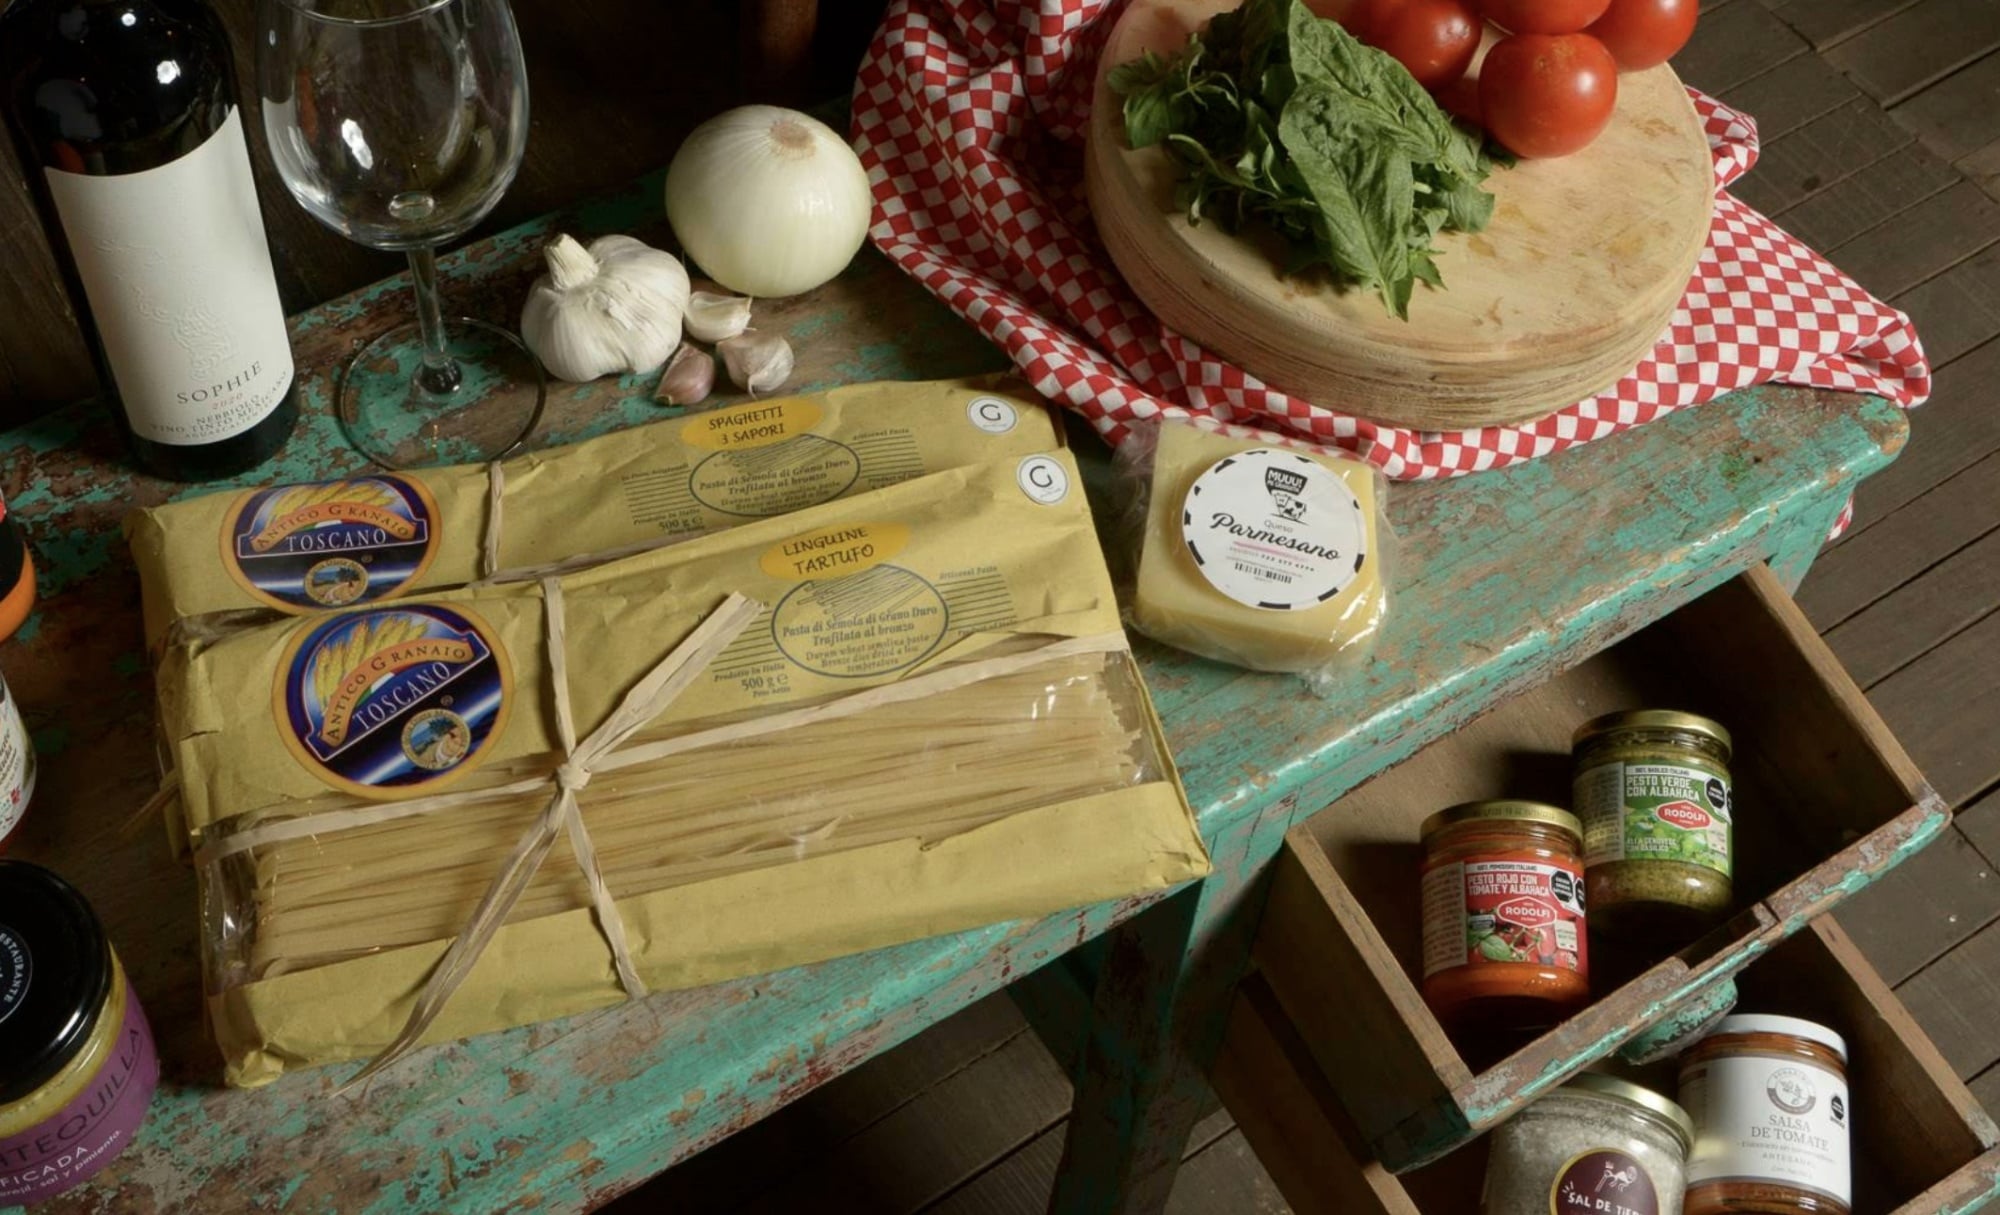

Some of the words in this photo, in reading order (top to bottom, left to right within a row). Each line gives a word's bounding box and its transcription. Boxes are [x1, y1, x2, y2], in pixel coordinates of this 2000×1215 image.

[176, 360, 262, 404] SOPHIE
[197, 394, 260, 425] NEBBIOLO
[709, 405, 784, 431] SPAGHETTI
[721, 433, 729, 445] 3
[733, 423, 785, 443] SAPORI
[700, 480, 726, 490] Pasta
[728, 477, 738, 486] di
[779, 470, 790, 479] di
[256, 509, 320, 548] ANTICO
[328, 504, 410, 537] GRANAIO
[658, 519, 680, 531] 500
[1209, 512, 1342, 561] Parmesano
[285, 527, 387, 552] TOSCANO
[783, 525, 870, 558] LINGUINE
[793, 543, 875, 576] TARTUFO
[783, 625, 811, 638] Pasta
[812, 621, 823, 633] di
[826, 616, 864, 631] Semola
[865, 613, 877, 625] di
[879, 610, 910, 623] Grano
[912, 606, 938, 618] Duro
[812, 631, 861, 647] Trafilata
[863, 626, 876, 637] al
[878, 622, 915, 635] bronzo
[326, 673, 367, 740] ANTICO
[370, 644, 466, 672] GRANAIO
[351, 660, 452, 731] TOSCANO
[741, 676, 764, 691] 500
[1626, 775, 1658, 787] PESTO
[1660, 776, 1692, 789] VERDE
[1626, 786, 1648, 797] CON
[1649, 786, 1701, 802] ALBAHACA
[1467, 873, 1494, 885] PESTO
[1496, 873, 1519, 884] ROJO
[1520, 873, 1538, 885] CON
[1468, 884, 1500, 897] TOMATE
[1501, 884, 1508, 894] Y
[1509, 884, 1551, 897] ALBAHACA
[1505, 906, 1551, 918] RODOLFI
[0, 932, 24, 1003] ESTAURANTE
[0, 1028, 139, 1167] TEQUILLA
[1768, 1113, 1811, 1133] SALSA
[1751, 1126, 1771, 1139] DE
[1773, 1127, 1830, 1152] TOMATE
[0, 1146, 88, 1187] FICADA
[1568, 1192, 1591, 1208] SAL
[1595, 1199, 1611, 1213] DE
